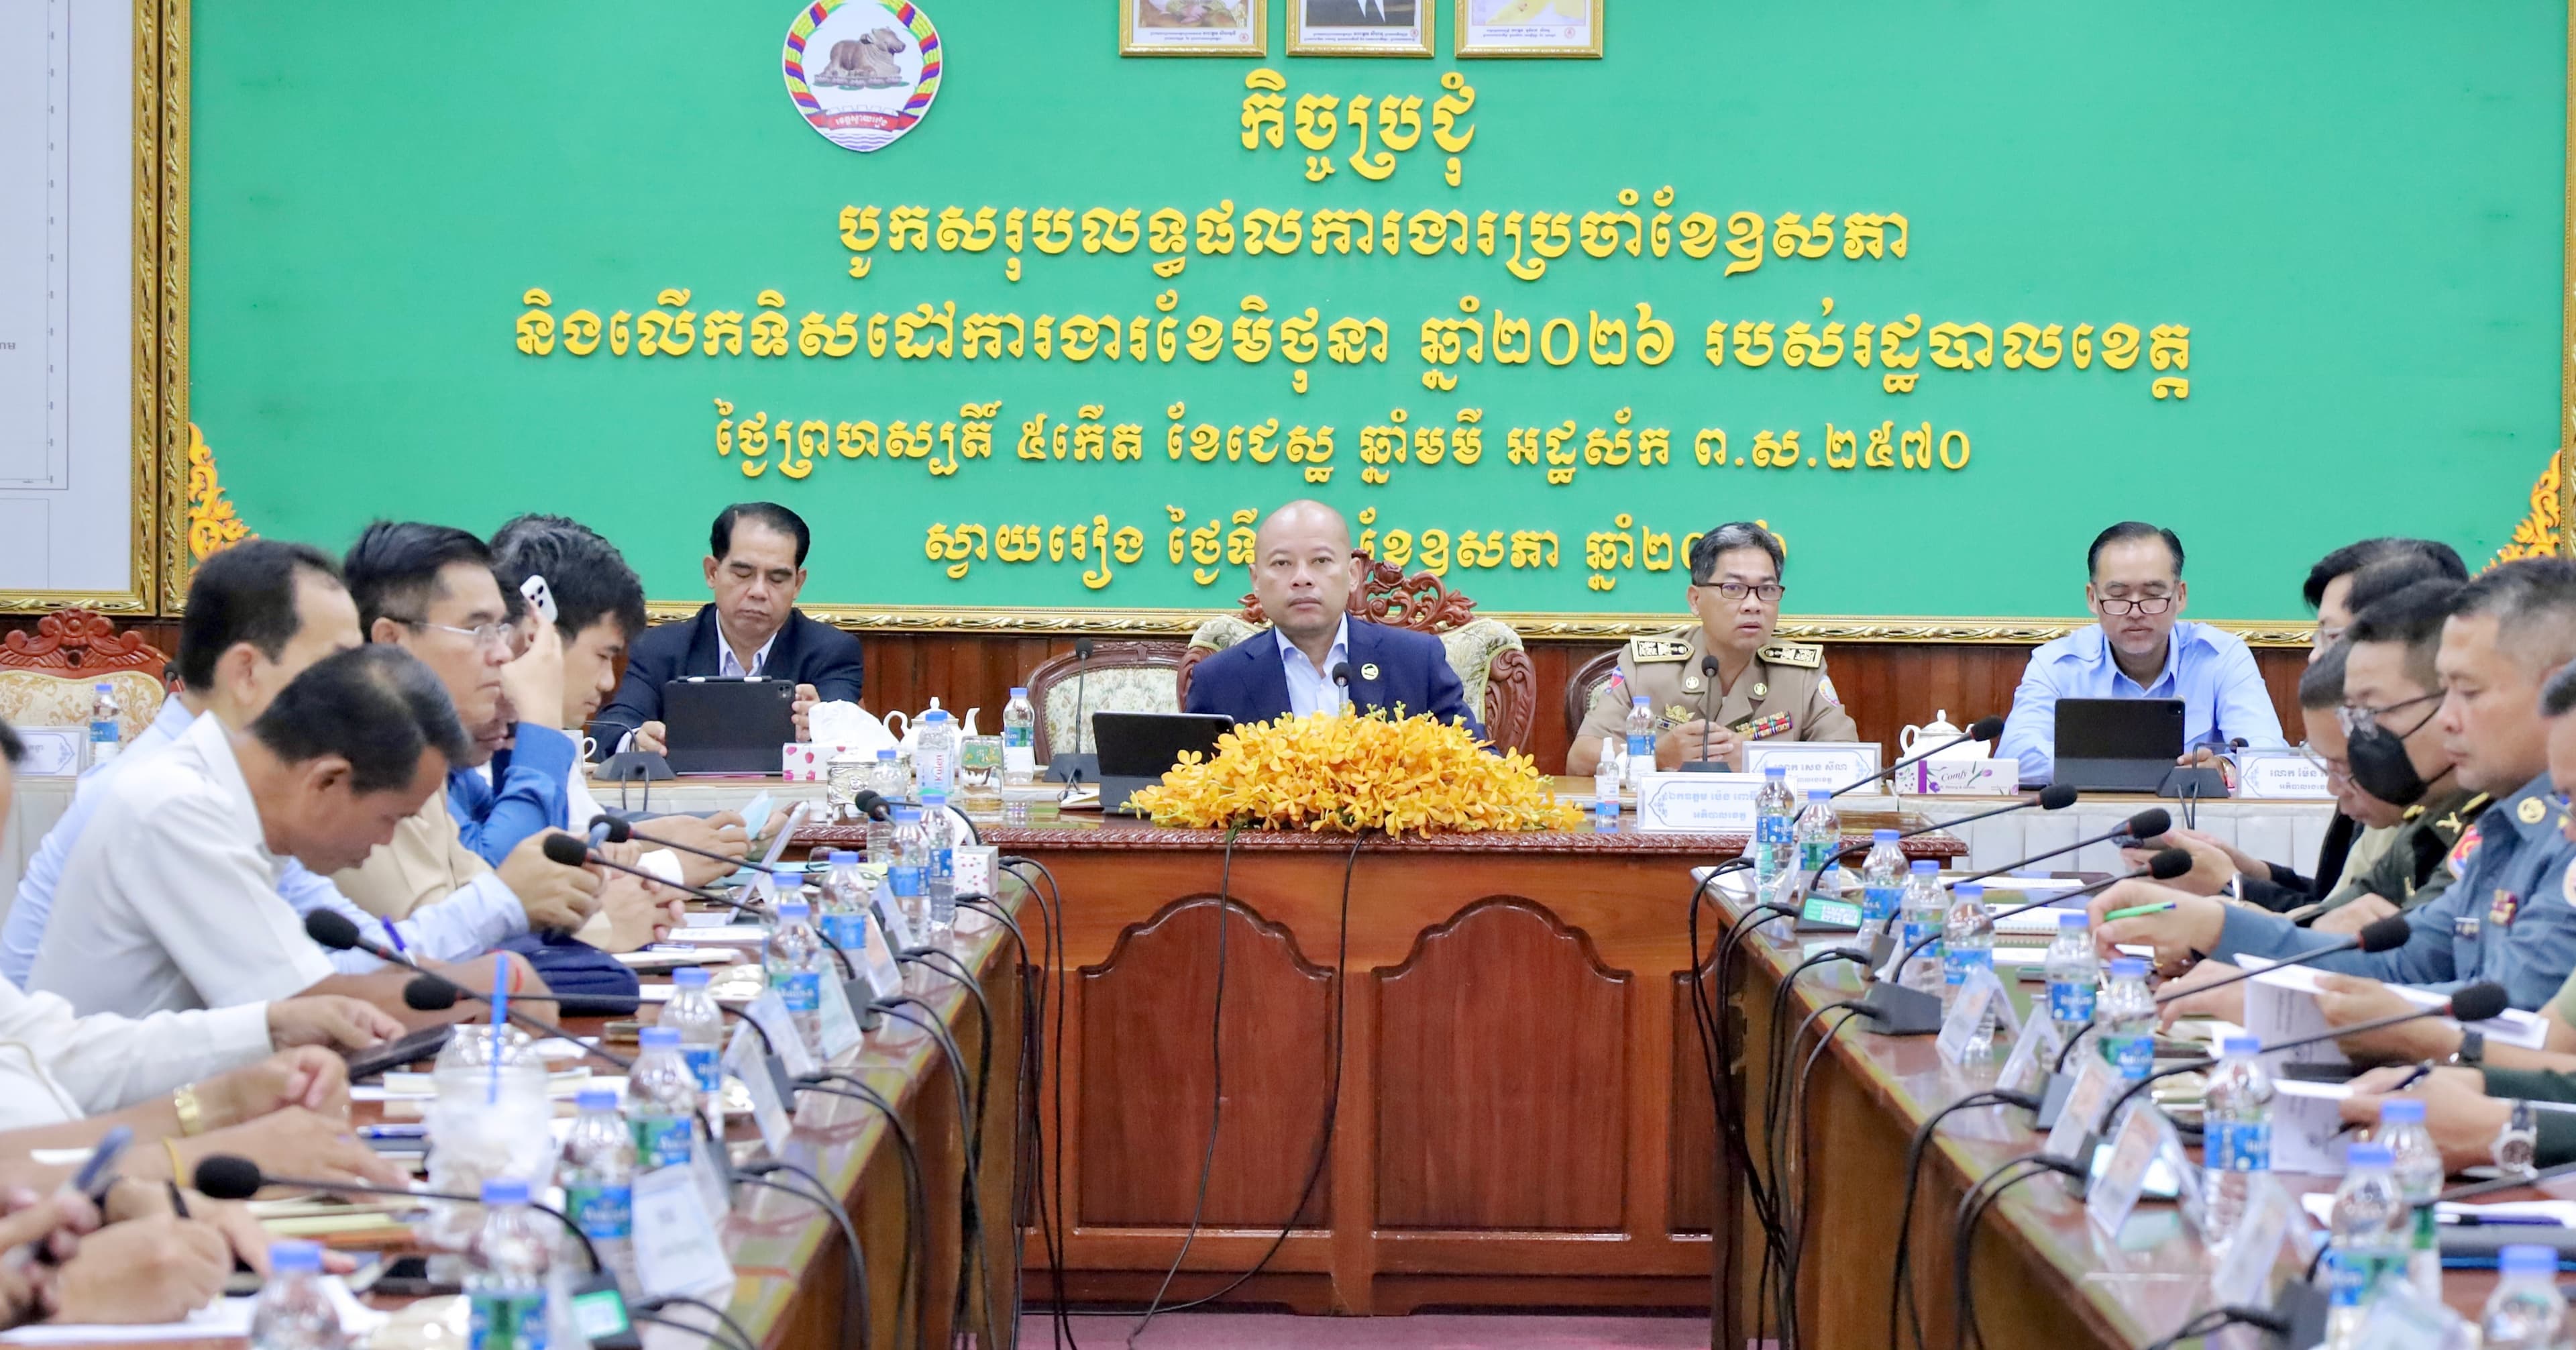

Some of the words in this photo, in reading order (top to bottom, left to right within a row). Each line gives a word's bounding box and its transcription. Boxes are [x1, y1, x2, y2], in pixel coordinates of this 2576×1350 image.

[1242, 68, 1475, 187] កិច្ចប្រជុំ
[839, 187, 1909, 282] បូកសរុបលទ្ធផលការងារប្រចាំខែឧសភា
[516, 289, 1389, 394] និងលើកទិសដៅការងារខែមិថុនា
[1421, 295, 1675, 391] ឆ្នាំ២០២៦
[1705, 298, 2191, 399] របស់រដ្ឋបាលខេត្ត
[1018, 405, 1142, 462] ៥កើត
[1360, 409, 1482, 484] ឆ្នាំមមី
[925, 515, 1144, 589] ស្វាយរៀង
[1166, 504, 1256, 585] ថ្ងៃទី
[1358, 507, 1559, 577] ខែឧសភា
[1586, 513, 1787, 590] ឆ្នាំ២
[1941, 770, 1968, 782] Comfy
